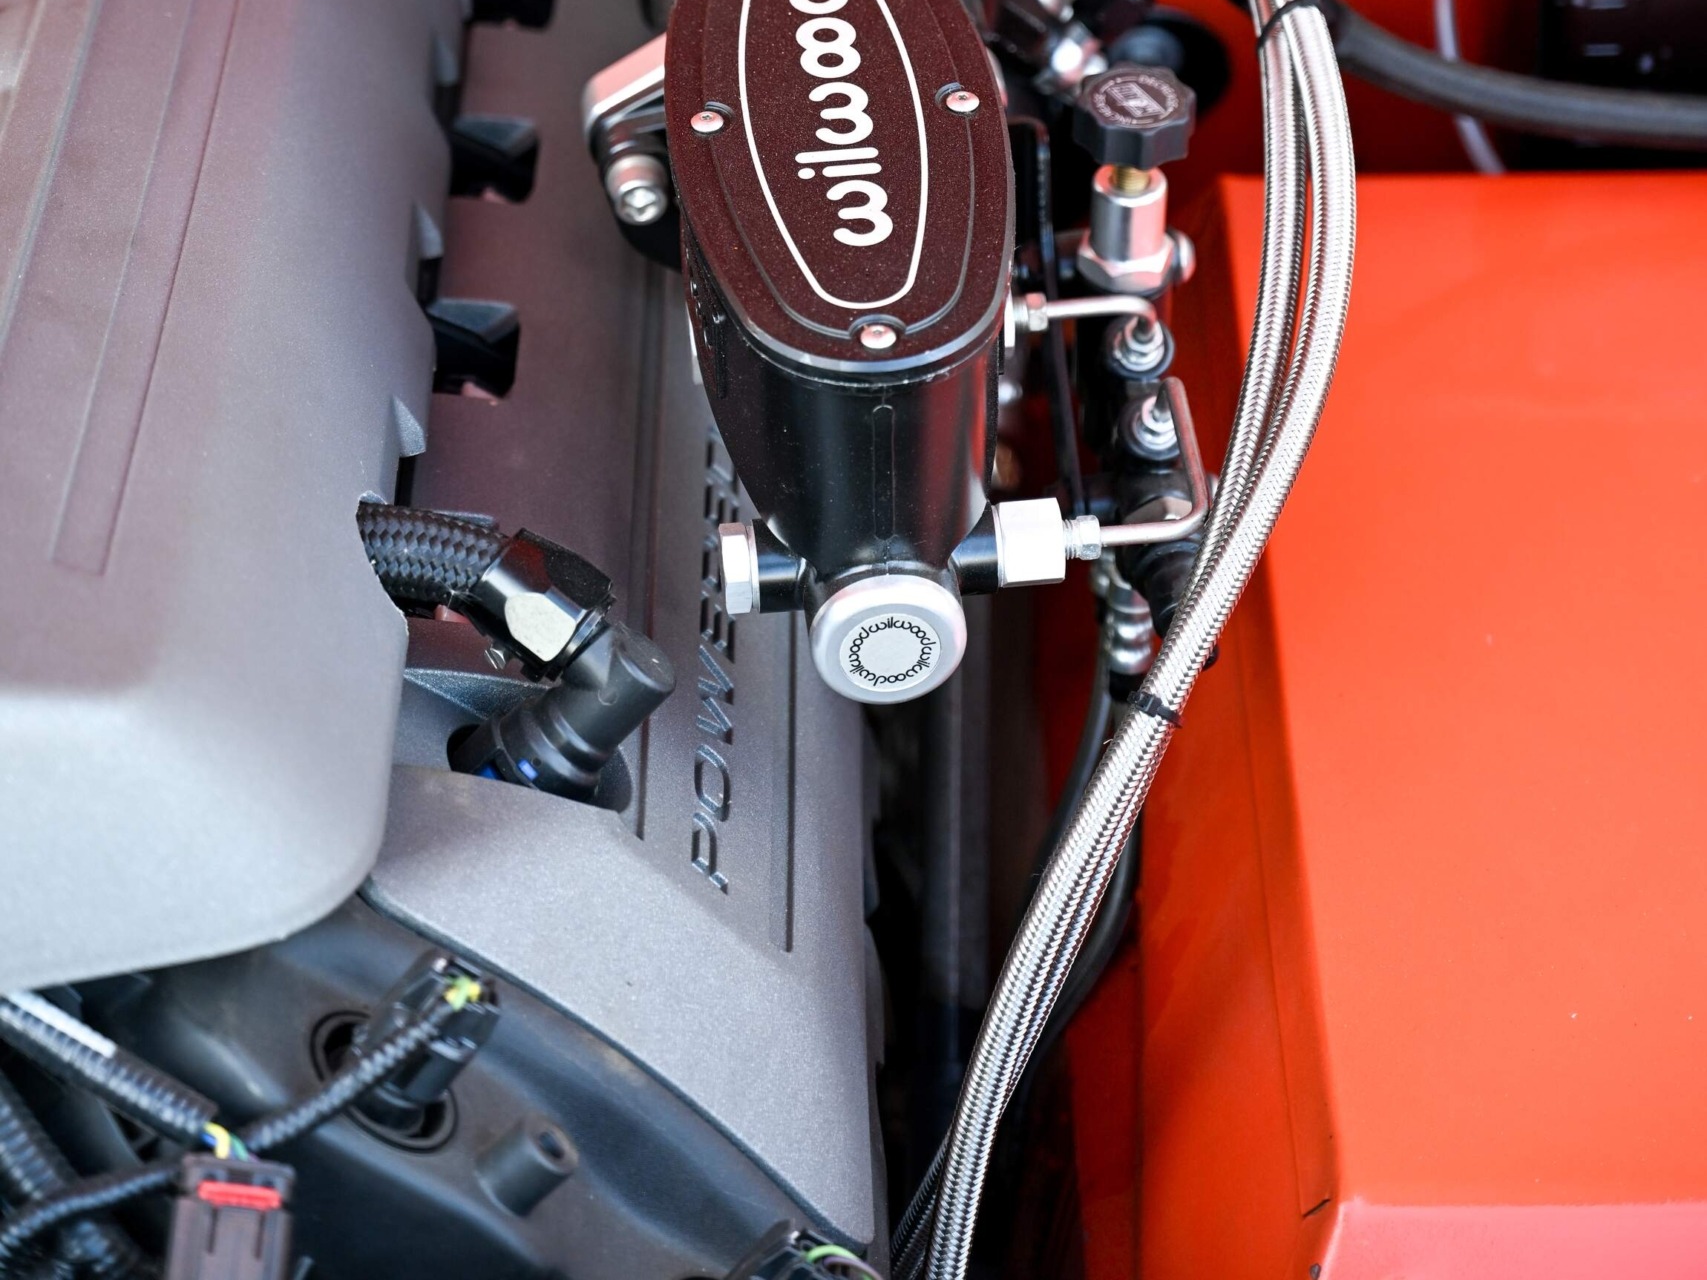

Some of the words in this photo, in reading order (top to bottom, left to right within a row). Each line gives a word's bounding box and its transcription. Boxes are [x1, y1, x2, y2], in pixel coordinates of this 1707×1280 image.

[868, 616, 936, 646] wilwood
[849, 627, 876, 682] wilwood
[873, 646, 932, 687] wilwood
